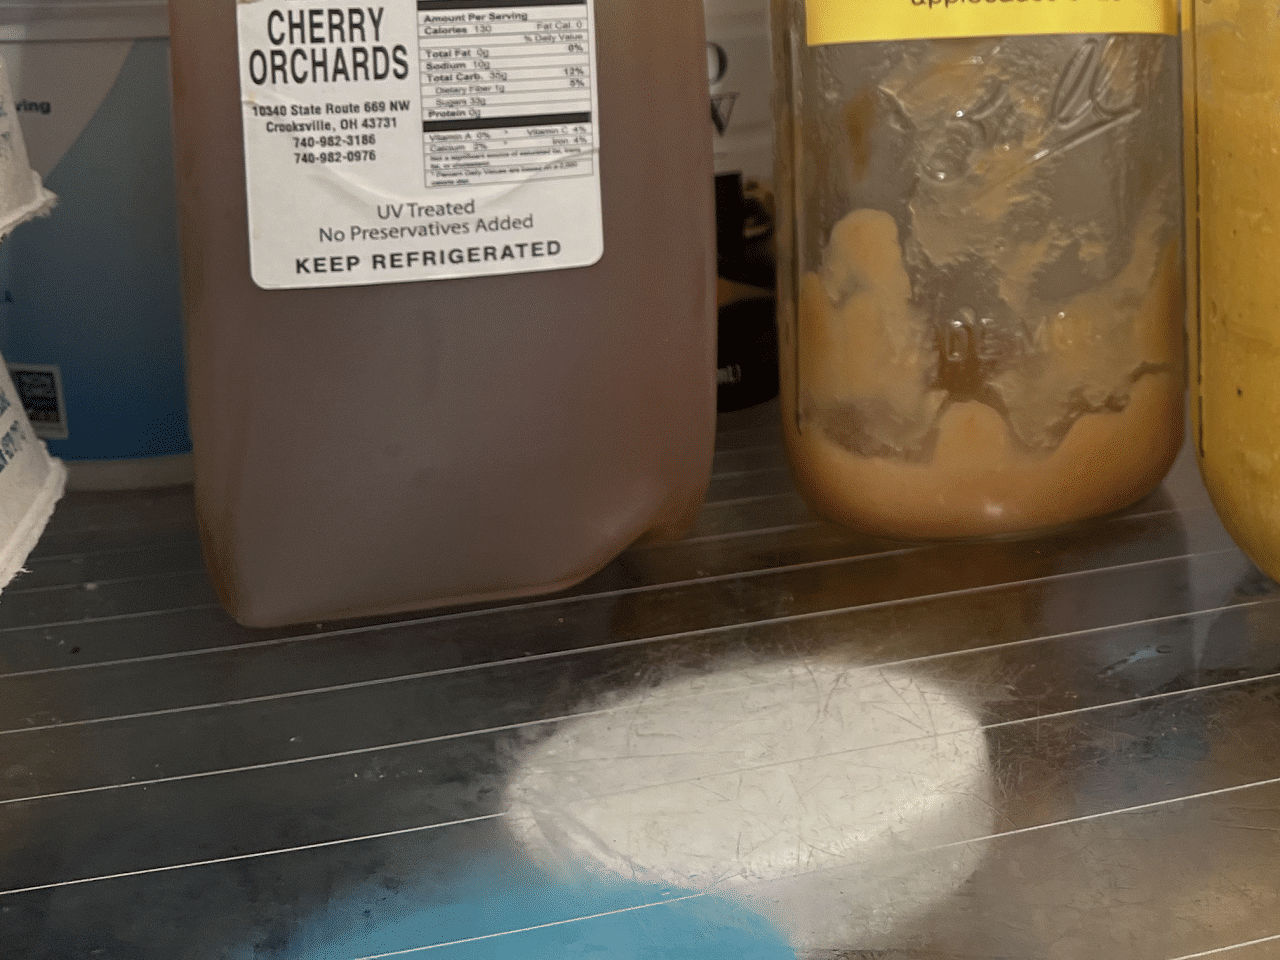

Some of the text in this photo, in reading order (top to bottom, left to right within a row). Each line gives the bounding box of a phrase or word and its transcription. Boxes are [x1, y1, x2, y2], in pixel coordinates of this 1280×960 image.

[424, 10, 528, 24] Amount Per Serving
[267, 6, 384, 46] CHERRY
[424, 24, 492, 35] Calories 130
[537, 22, 552, 31] Fat
[534, 33, 557, 43] Daily
[558, 32, 584, 41] Value
[425, 50, 451, 59] Total
[454, 48, 471, 58] Fat
[249, 44, 410, 86] ORCHARDS
[426, 61, 467, 71] Sodium
[426, 73, 453, 83] Total
[469, 84, 492, 93] Fiber
[252, 105, 288, 117] 10340
[291, 103, 322, 116] State
[325, 102, 360, 115] Route
[389, 100, 411, 112] NW
[436, 98, 467, 108] Sugars
[428, 108, 467, 119] Protein
[266, 117, 398, 133] Crooksville, OH 43731
[377, 198, 476, 221] UV Treated
[318, 213, 534, 243] No Preservatives Added
[295, 239, 562, 274] KEEP REFRIGERATED
